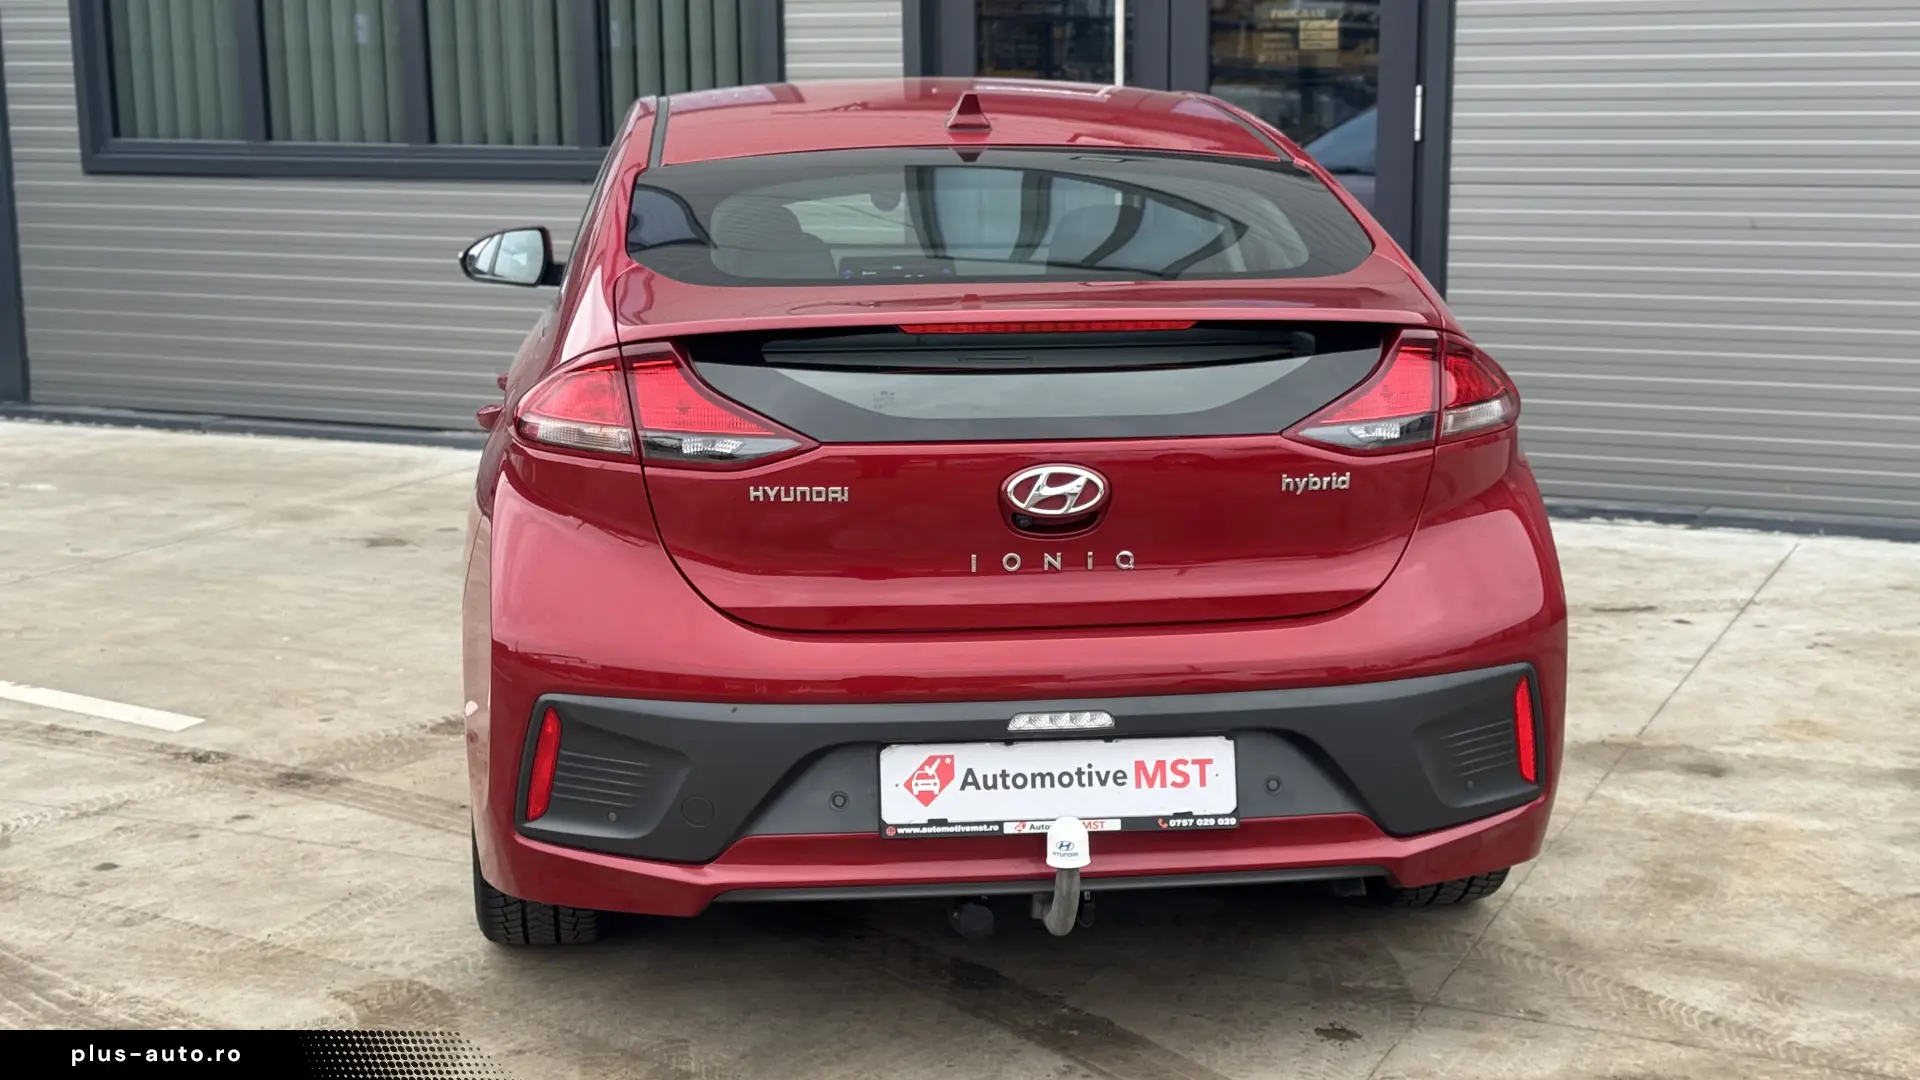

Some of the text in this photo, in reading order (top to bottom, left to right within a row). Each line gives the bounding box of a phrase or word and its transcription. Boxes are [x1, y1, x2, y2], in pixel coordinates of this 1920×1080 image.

[1281, 472, 1351, 495] hybrid
[749, 486, 849, 502] HYUNDAI
[971, 550, 1135, 573] IONIQ
[959, 758, 1214, 791] Automotive MST
[897, 825, 999, 834] www.automotivemst.ro
[1169, 817, 1236, 827] 0757 029 029
